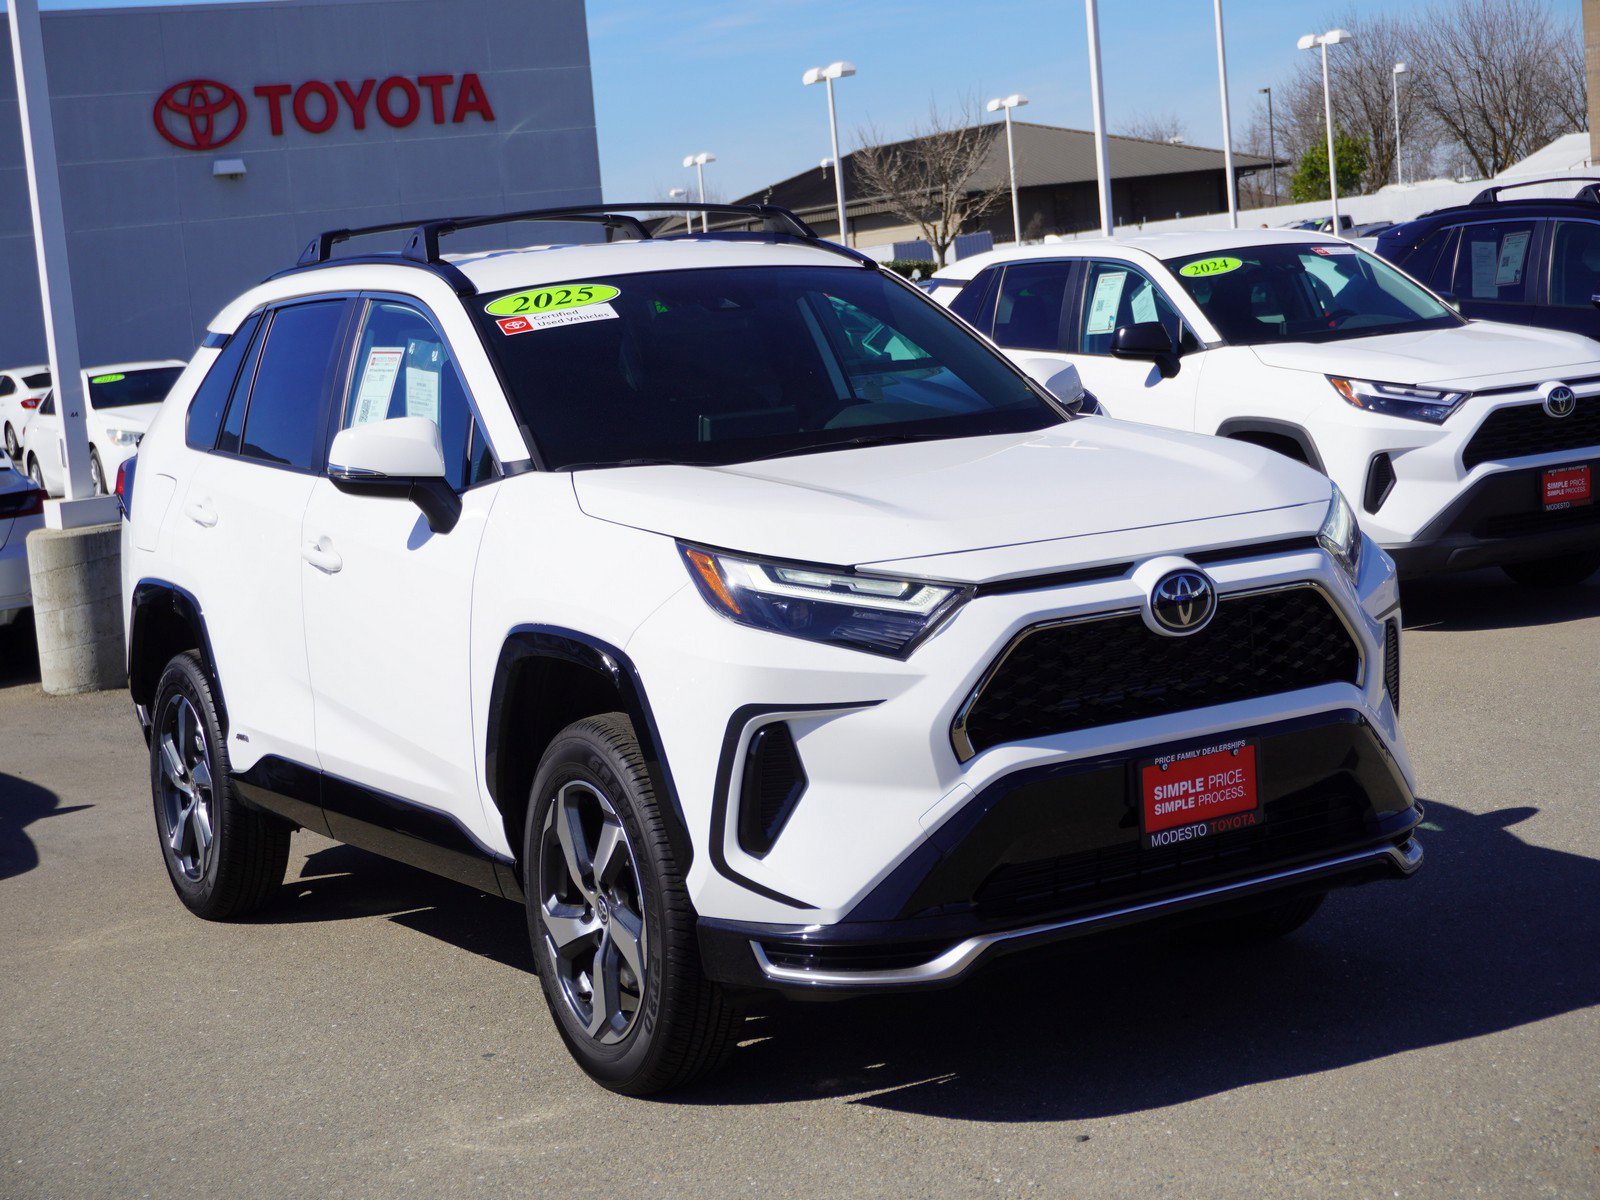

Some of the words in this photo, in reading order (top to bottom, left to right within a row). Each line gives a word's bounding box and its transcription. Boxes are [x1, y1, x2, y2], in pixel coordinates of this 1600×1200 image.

[254, 73, 495, 136] TOYOTA
[1191, 259, 1229, 275] 2024
[512, 286, 594, 313] 2025
[533, 309, 579, 321] Certified
[537, 318, 565, 327] Used
[566, 311, 610, 324] Vehicles
[1547, 480, 1568, 490] SIMPLE
[1546, 501, 1570, 511] MODESTO
[1154, 754, 1176, 765] PRICE
[1177, 749, 1201, 761] FAMILY
[1202, 740, 1246, 756] DEALERSHIPS
[1154, 777, 1205, 801] SIMPLE
[1208, 768, 1246, 789] PRICE.
[1154, 797, 1195, 815] SIMPLE
[1198, 786, 1247, 806] PROCESS.
[1151, 823, 1207, 848] MODESTO
[1211, 813, 1256, 833] TOYOTA
